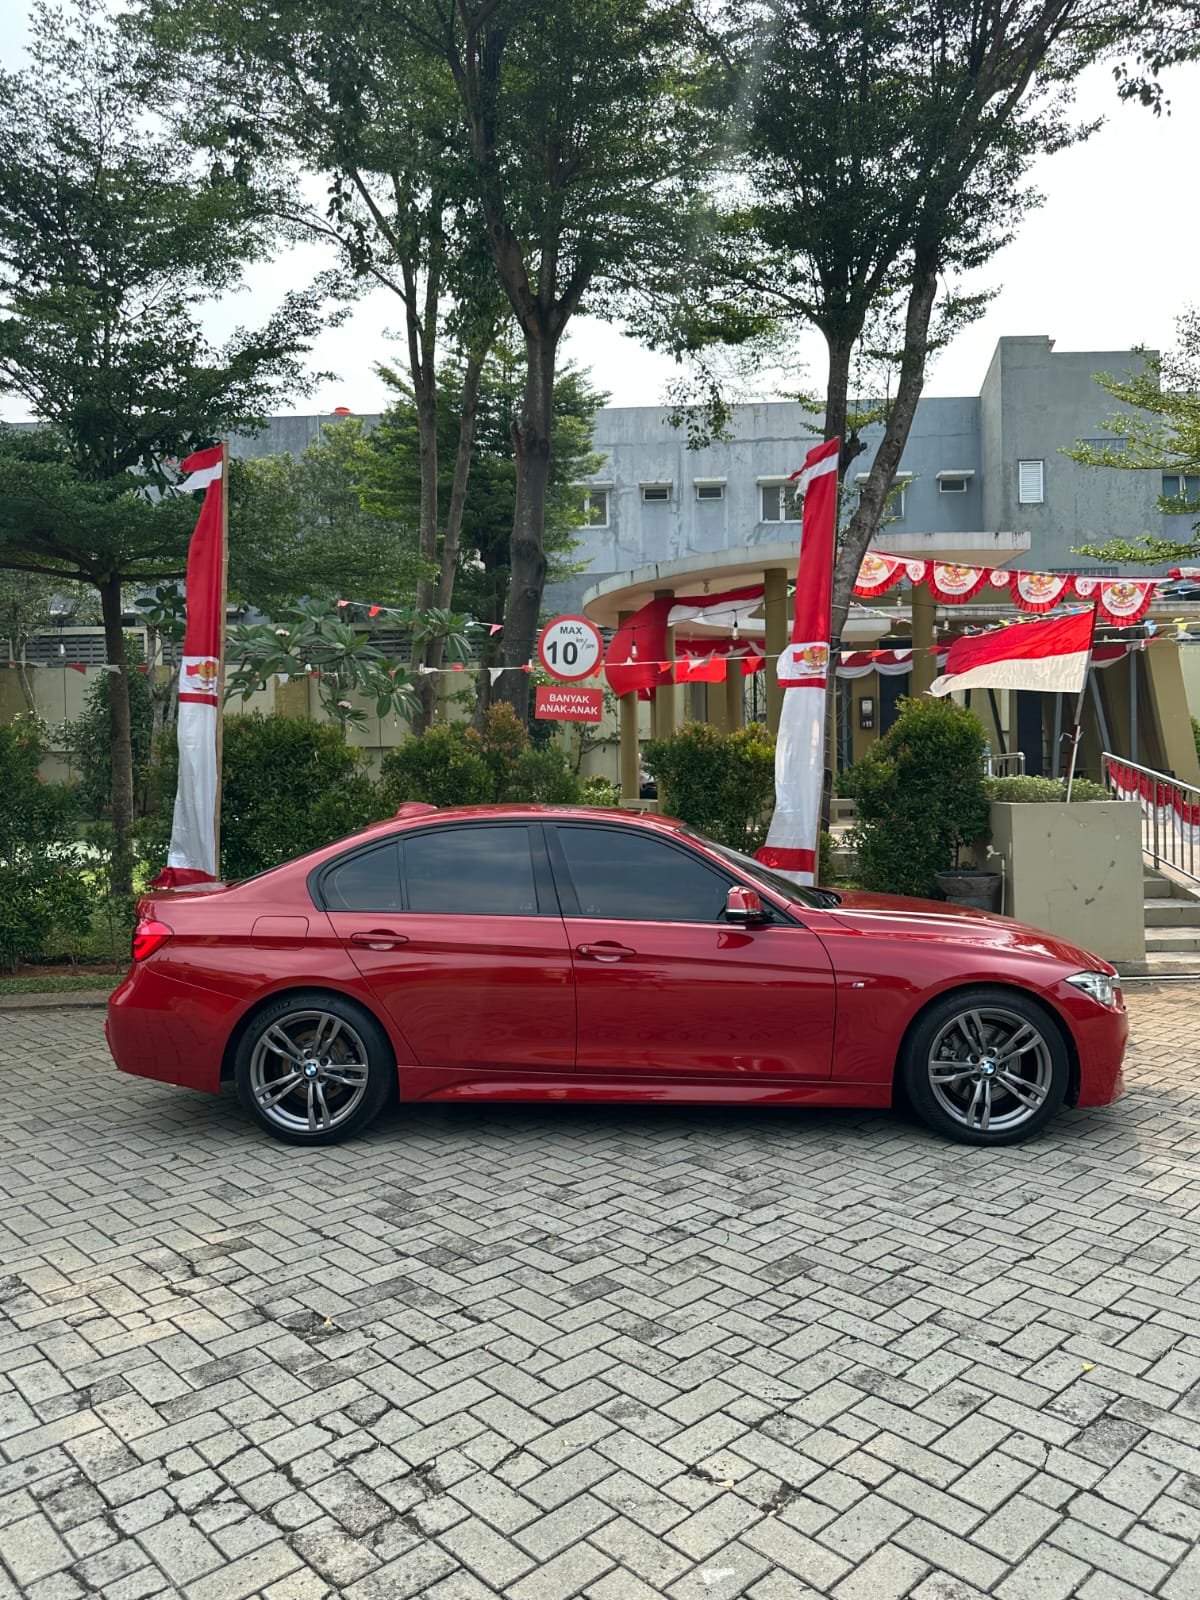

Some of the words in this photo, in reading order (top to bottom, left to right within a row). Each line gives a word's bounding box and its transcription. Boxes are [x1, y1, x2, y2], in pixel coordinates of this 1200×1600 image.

[547, 641, 578, 665] 10
[549, 693, 589, 703] BANYAK
[540, 704, 598, 714] ANAK-ANAK
